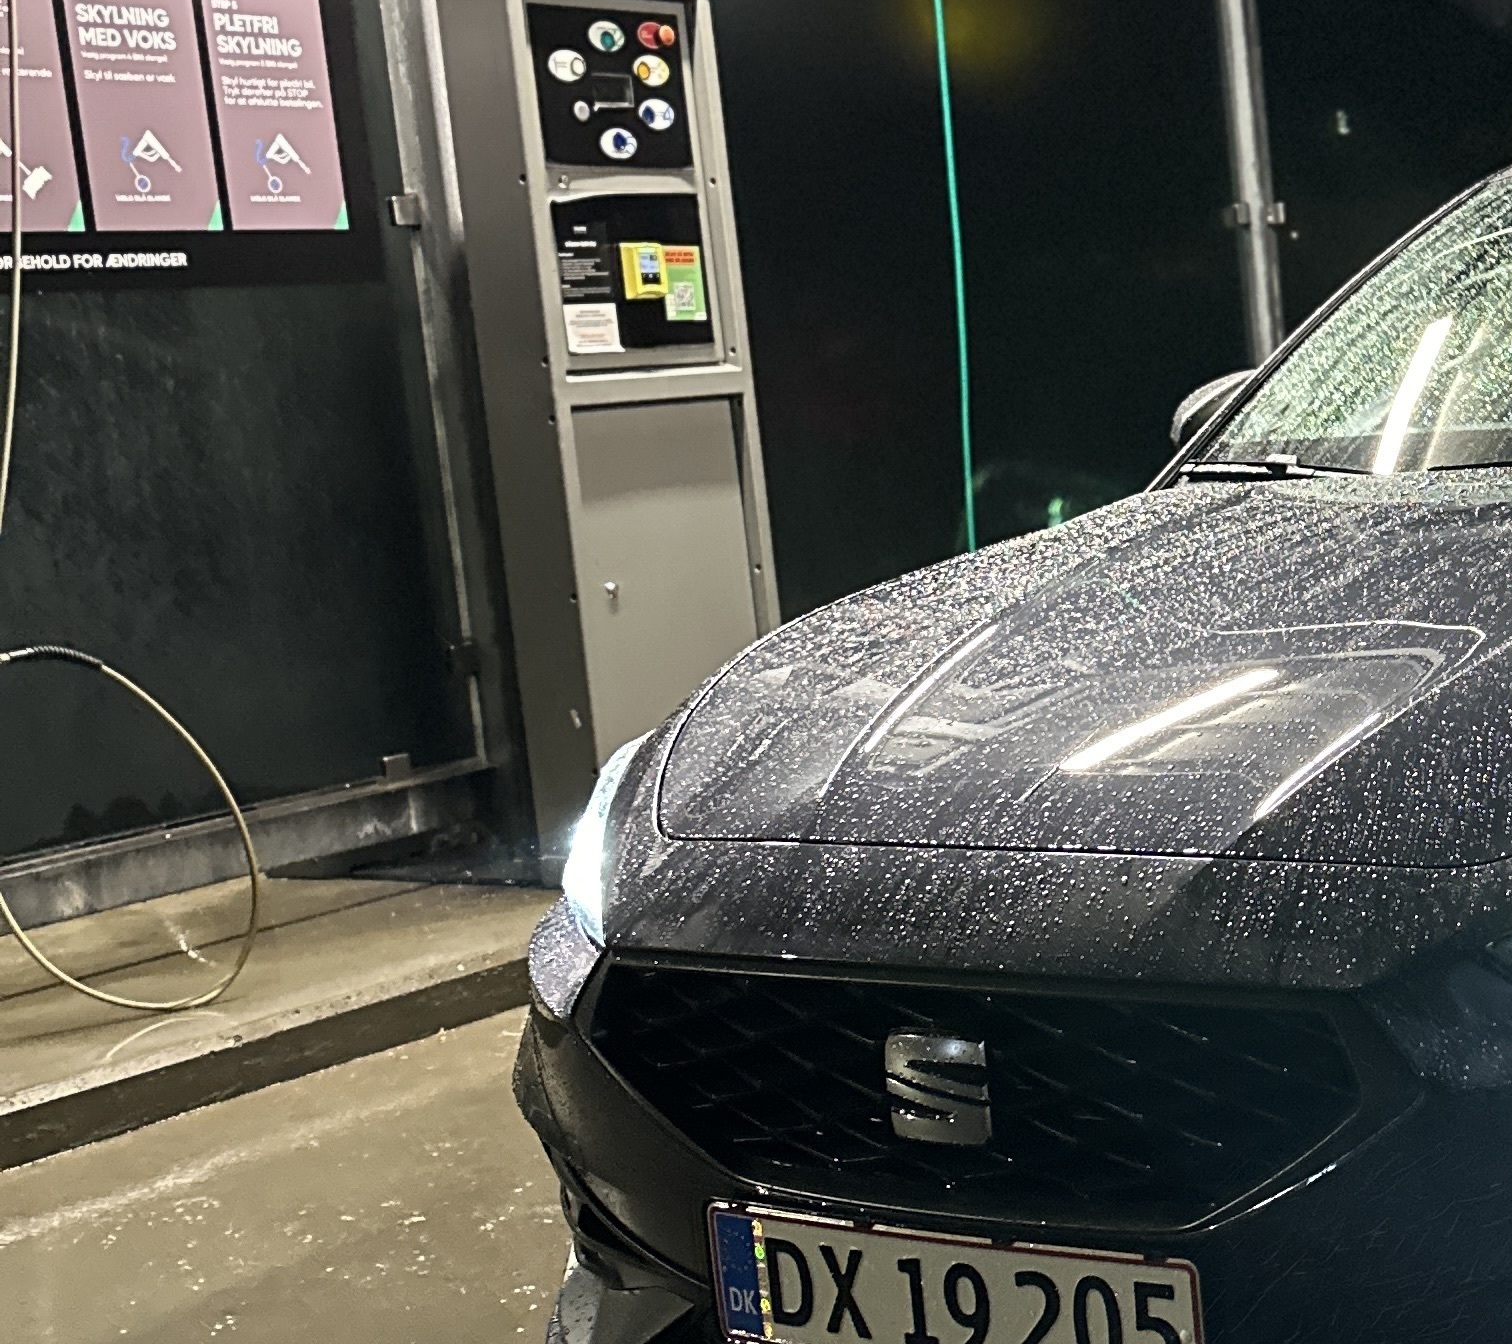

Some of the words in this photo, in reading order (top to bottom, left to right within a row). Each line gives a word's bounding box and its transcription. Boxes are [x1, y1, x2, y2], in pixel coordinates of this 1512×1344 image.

[75, 3, 170, 28] SKYLNING
[213, 12, 279, 34] PLETFRI
[78, 26, 121, 47] MED
[123, 29, 177, 51] VOKS
[216, 34, 302, 57] SKYLNING
[73, 253, 103, 269] FOR
[106, 252, 188, 268] ÆNDRINGER
[763, 1236, 873, 1340] DX
[729, 1286, 758, 1316] DK
